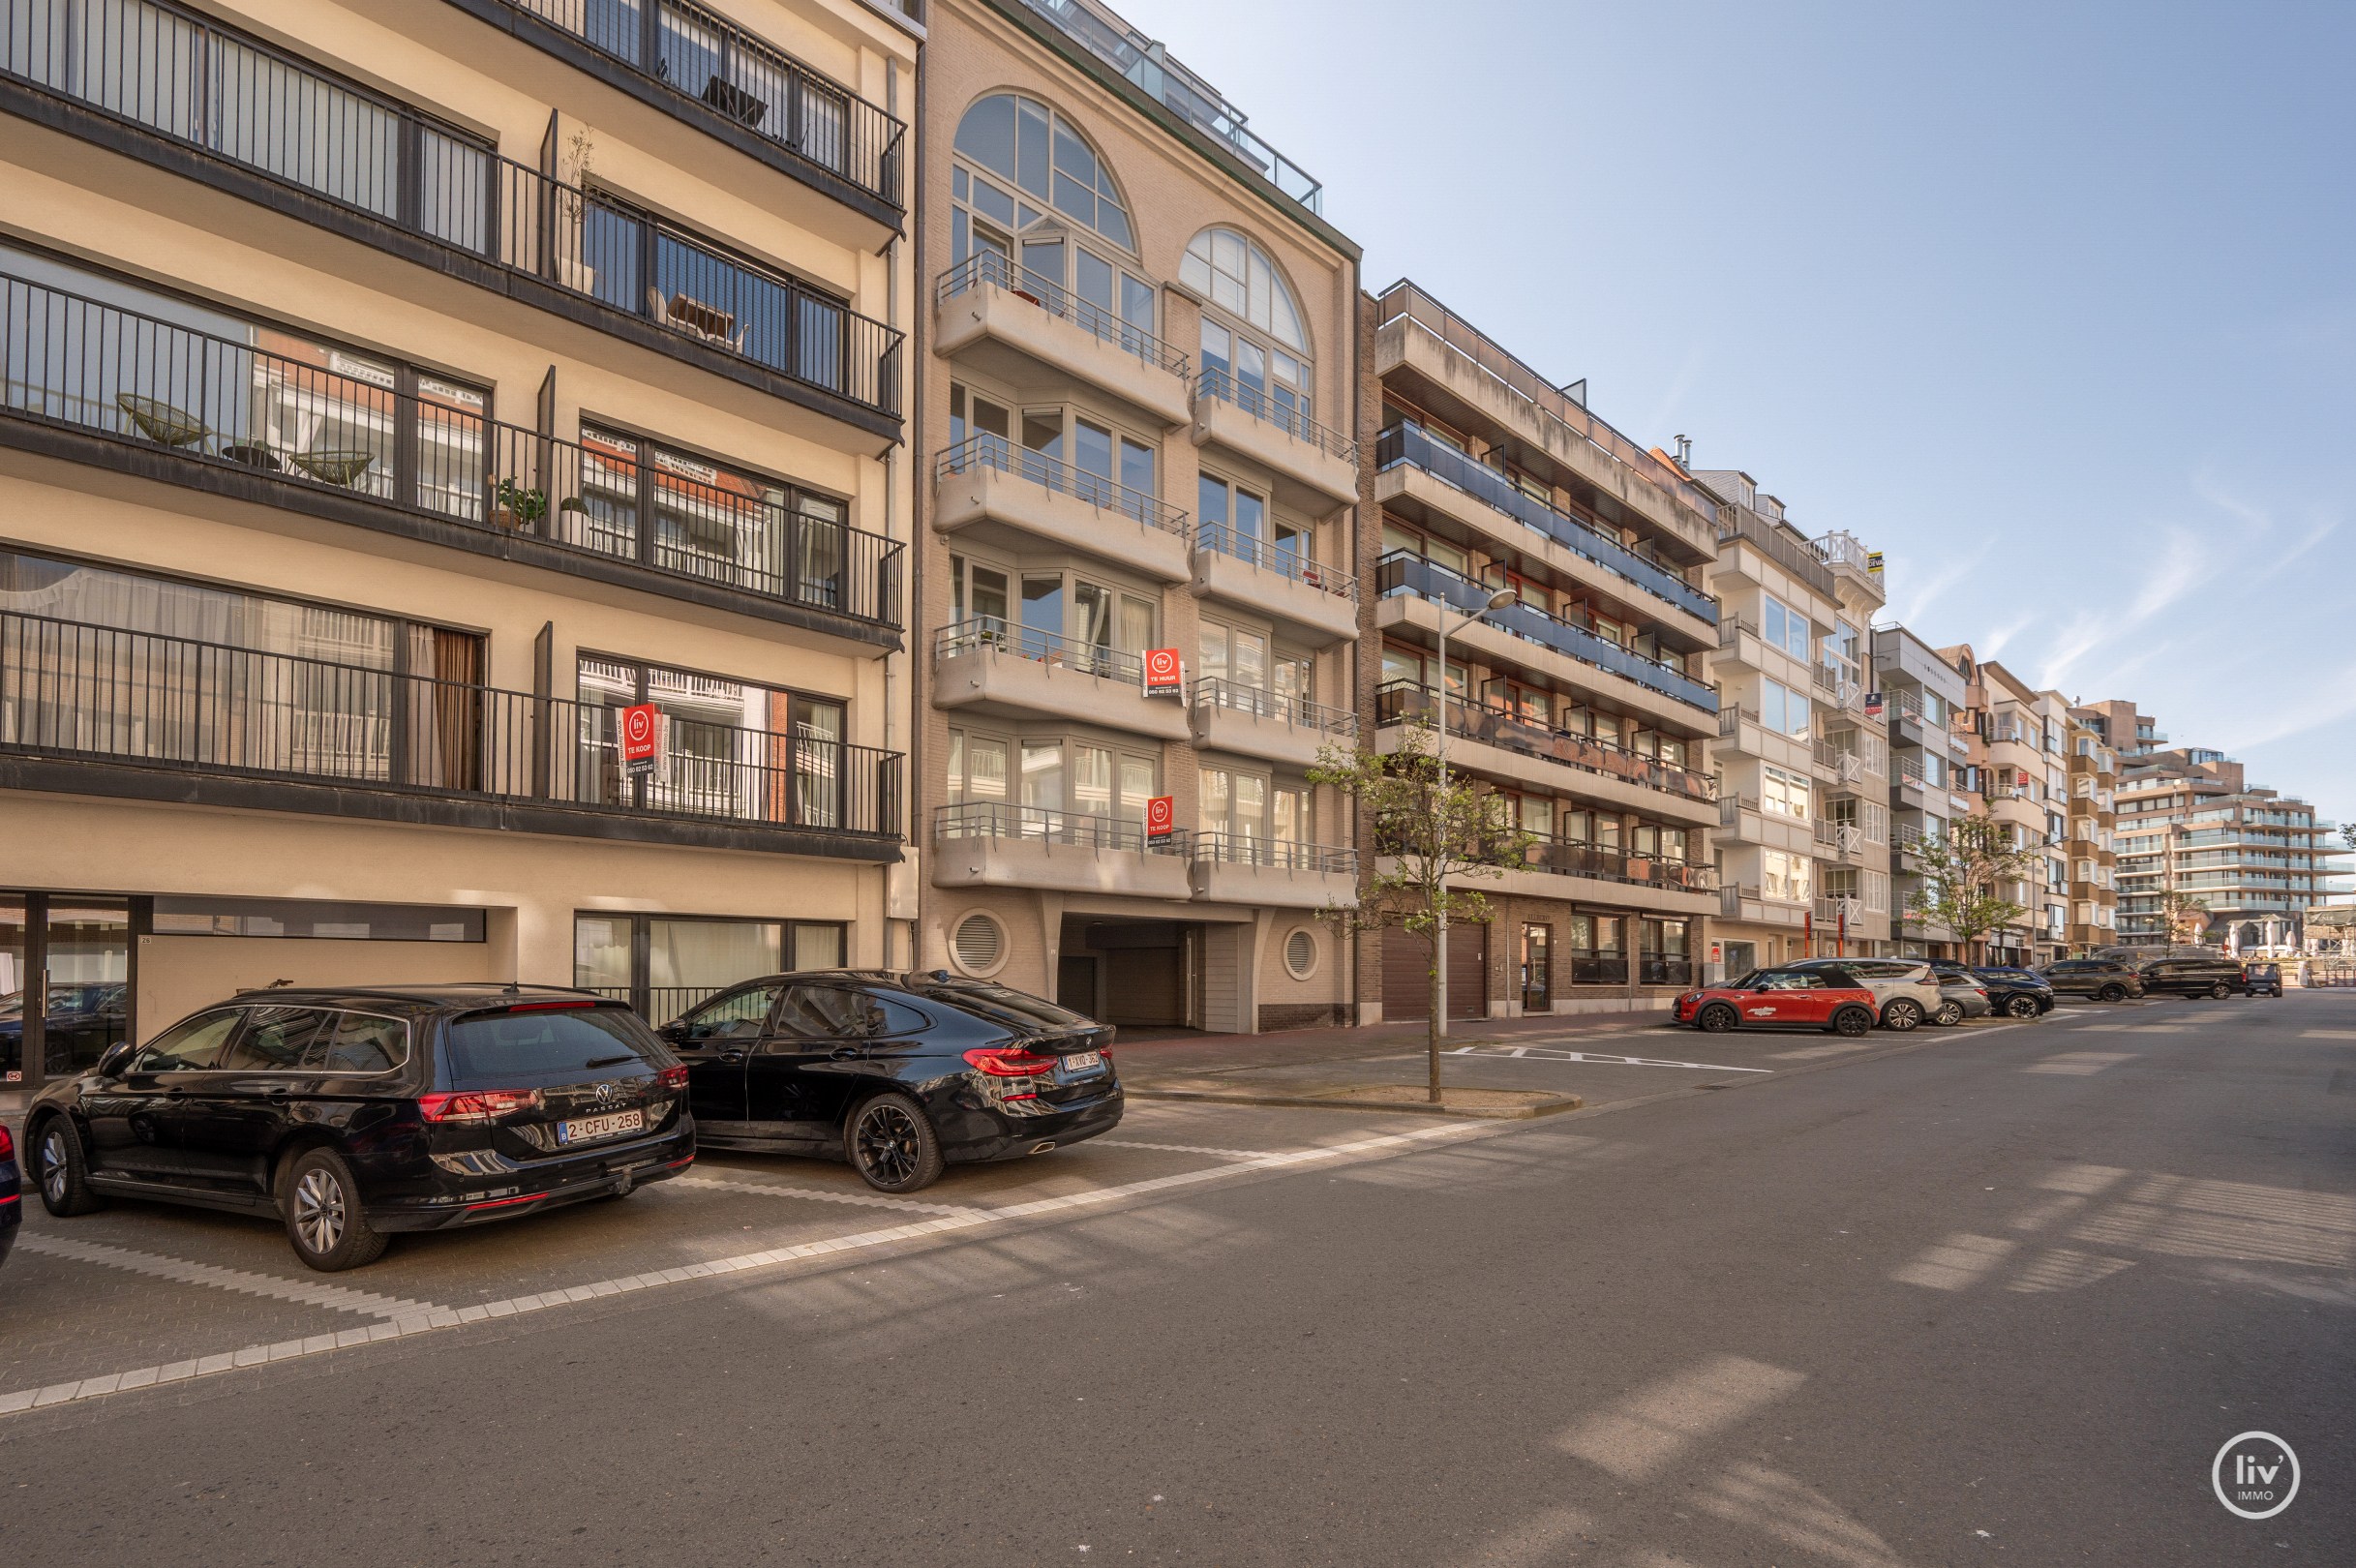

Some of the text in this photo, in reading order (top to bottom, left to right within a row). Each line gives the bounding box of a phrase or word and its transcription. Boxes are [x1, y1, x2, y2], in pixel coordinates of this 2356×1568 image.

[633, 716, 646, 730] liv'
[635, 743, 651, 753] KOOP
[586, 1102, 626, 1114] PASSAT
